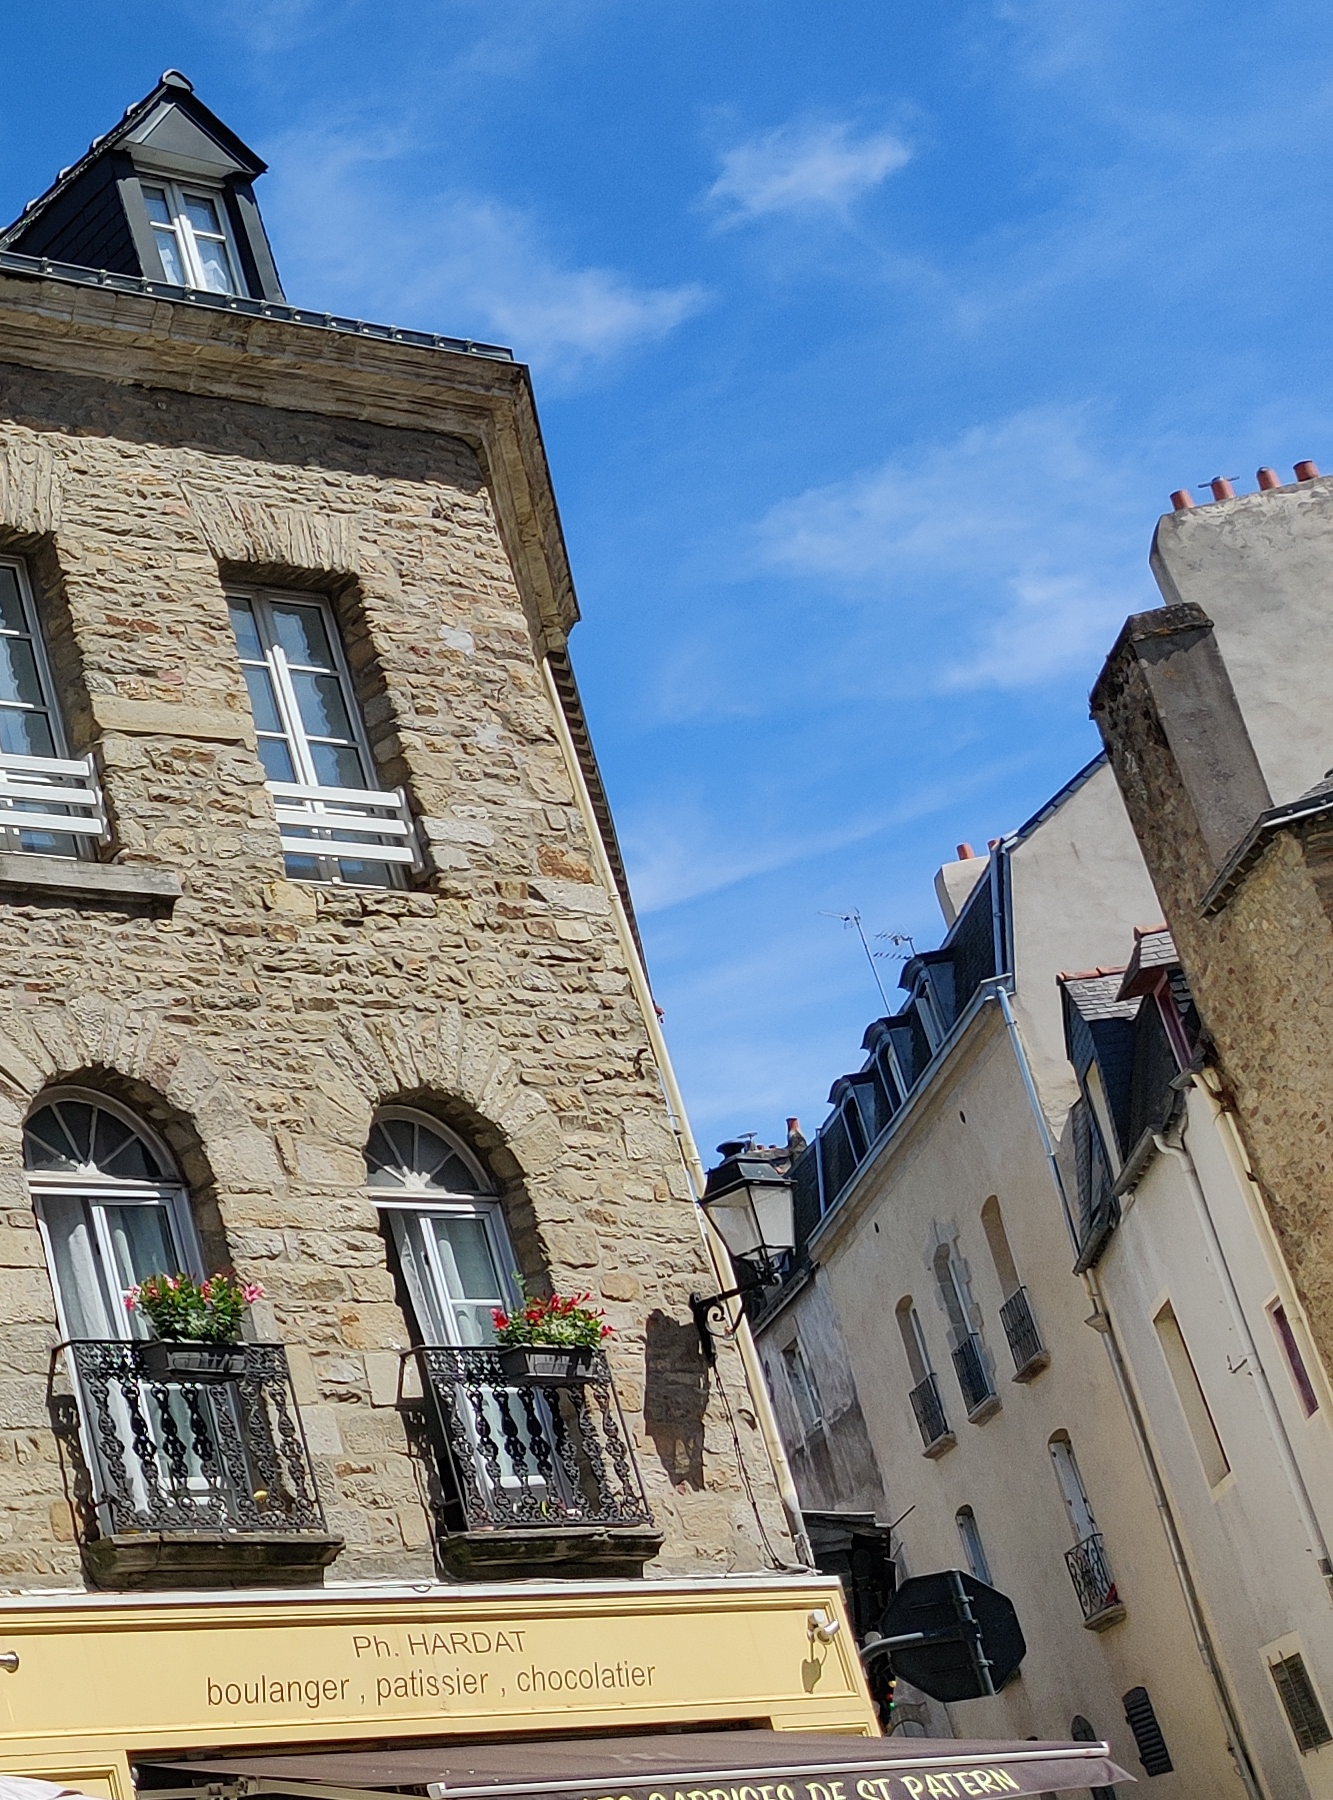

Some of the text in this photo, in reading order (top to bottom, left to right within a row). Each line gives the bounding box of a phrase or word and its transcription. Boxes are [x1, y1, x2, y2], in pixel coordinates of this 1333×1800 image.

[352, 1629, 527, 1658] Ph. HARDAT
[206, 1675, 350, 1709] boulanger
[375, 1668, 489, 1706] patissier
[516, 1660, 656, 1693] chocolatier
[856, 1778, 890, 1800] ST
[900, 1767, 1020, 1800] PATERN
